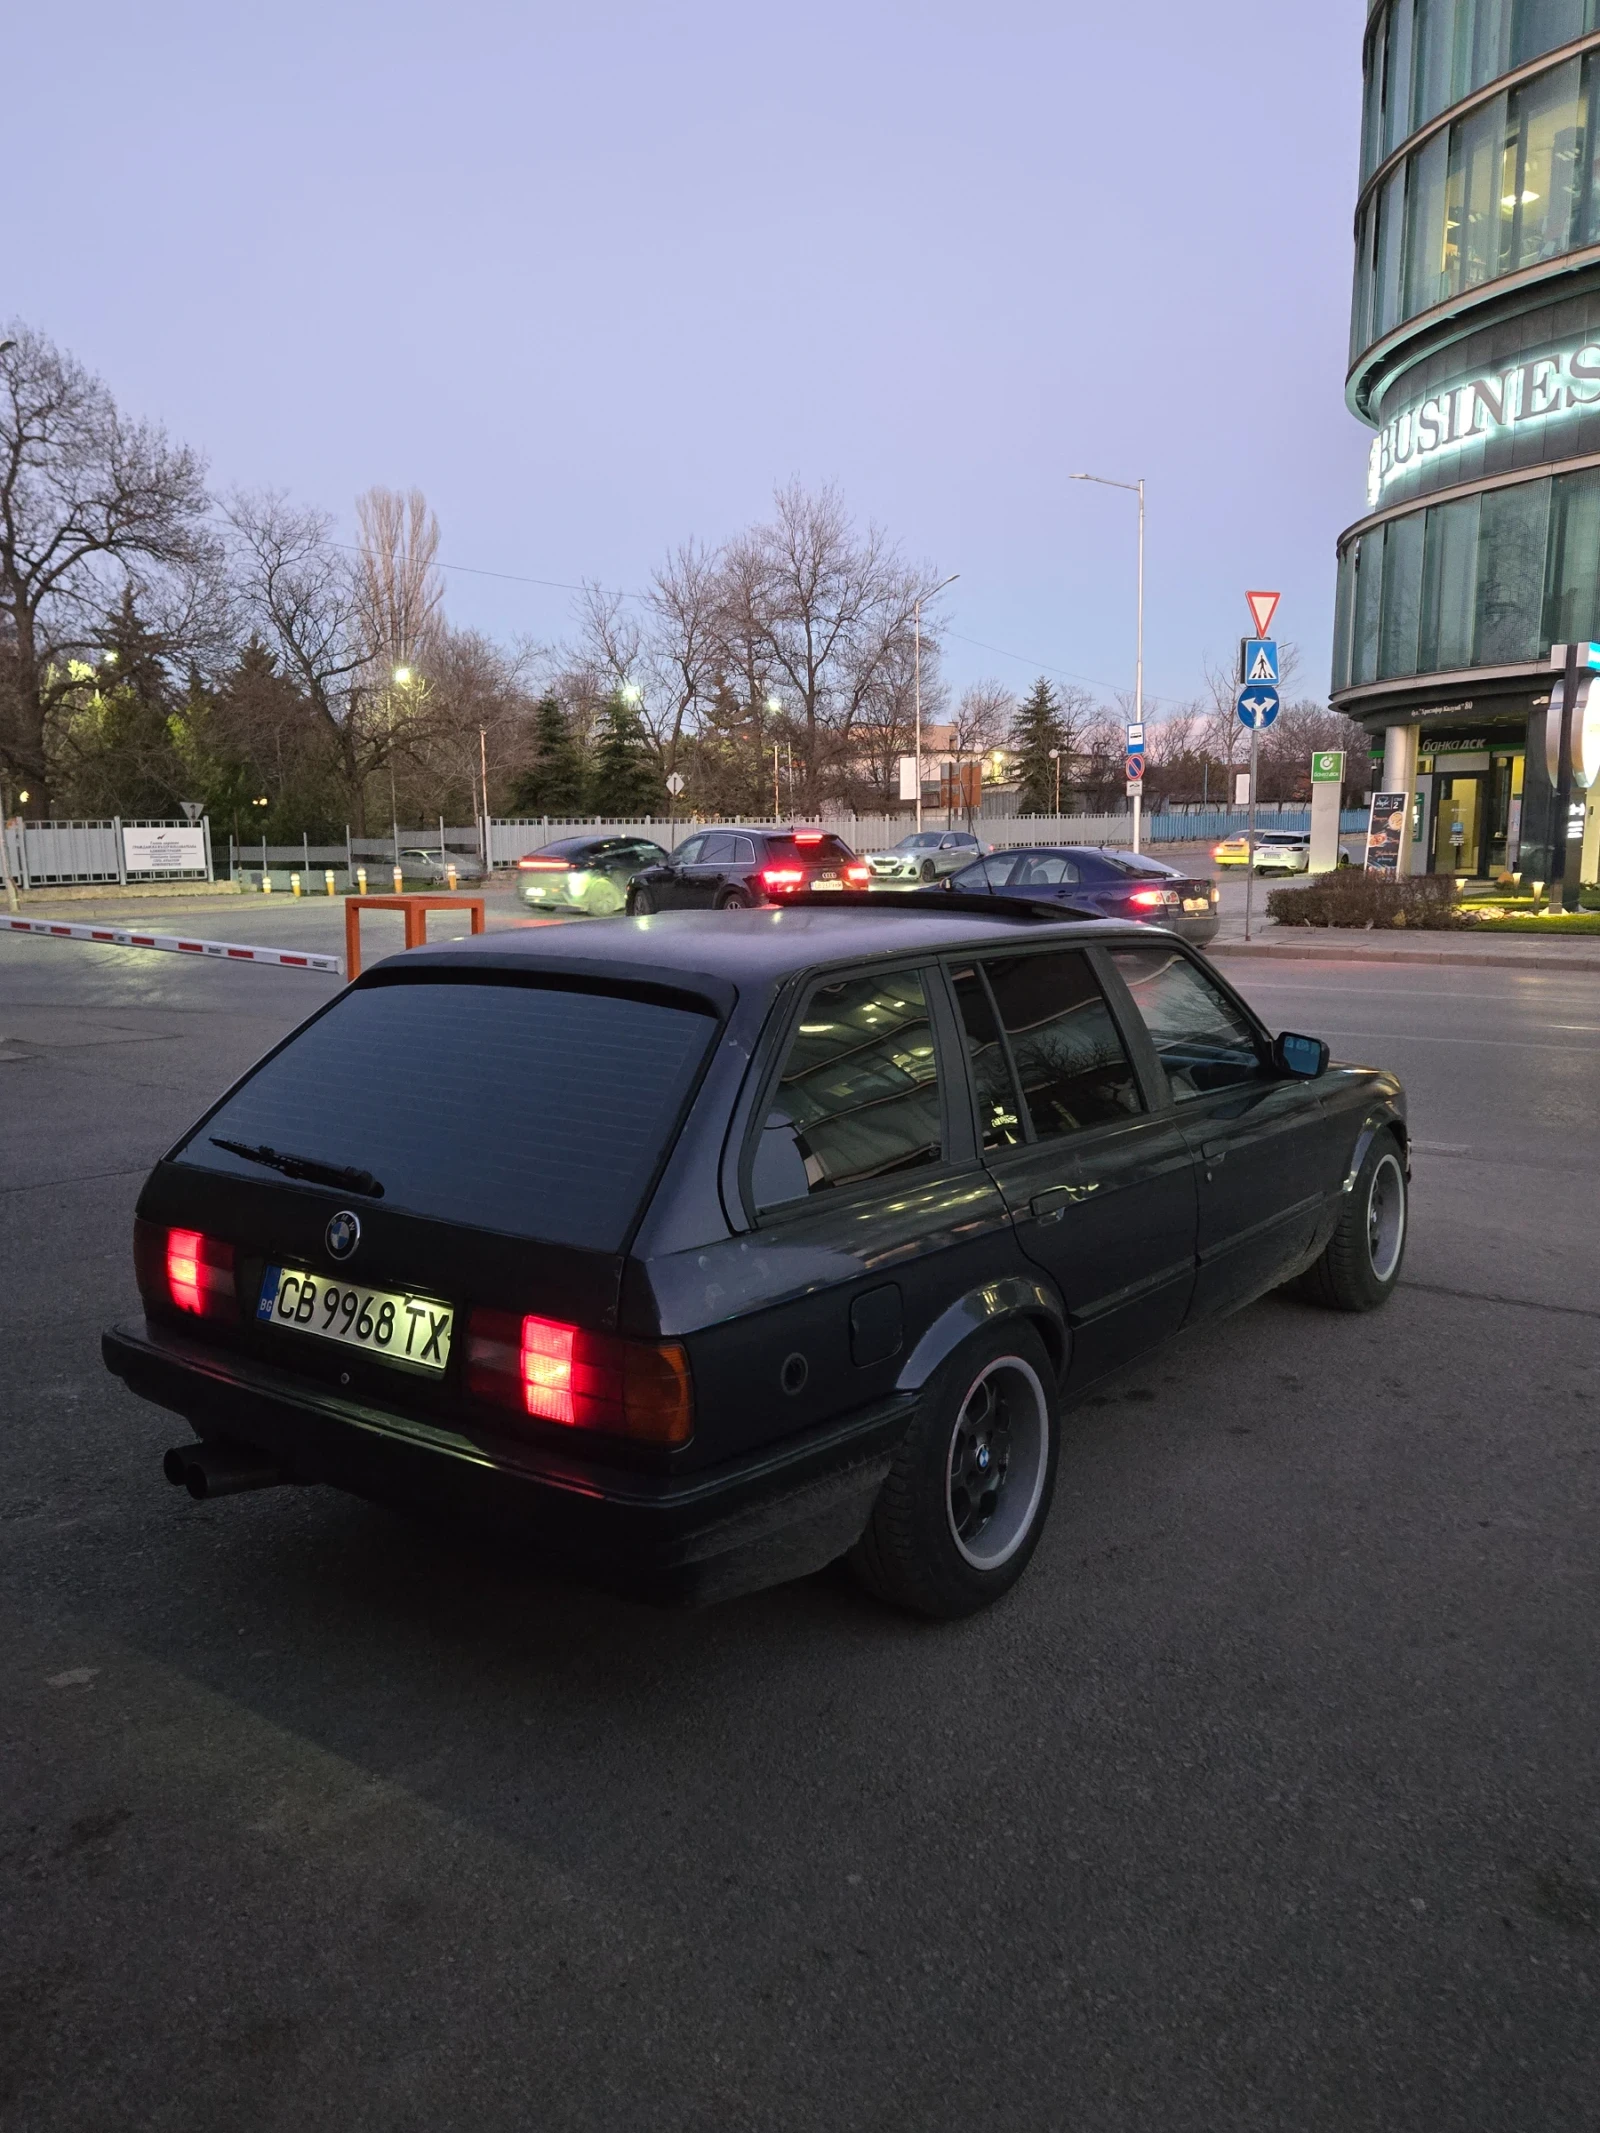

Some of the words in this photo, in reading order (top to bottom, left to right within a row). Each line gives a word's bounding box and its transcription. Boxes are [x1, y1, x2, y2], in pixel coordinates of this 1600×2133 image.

[1465, 701, 1473, 710] 80
[1422, 739, 1460, 752] банка
[1392, 801, 1399, 809] 2
[259, 1299, 272, 1312] BG
[277, 1276, 317, 1323] CB
[321, 1285, 397, 1345] 9968
[404, 1305, 450, 1363] TX
